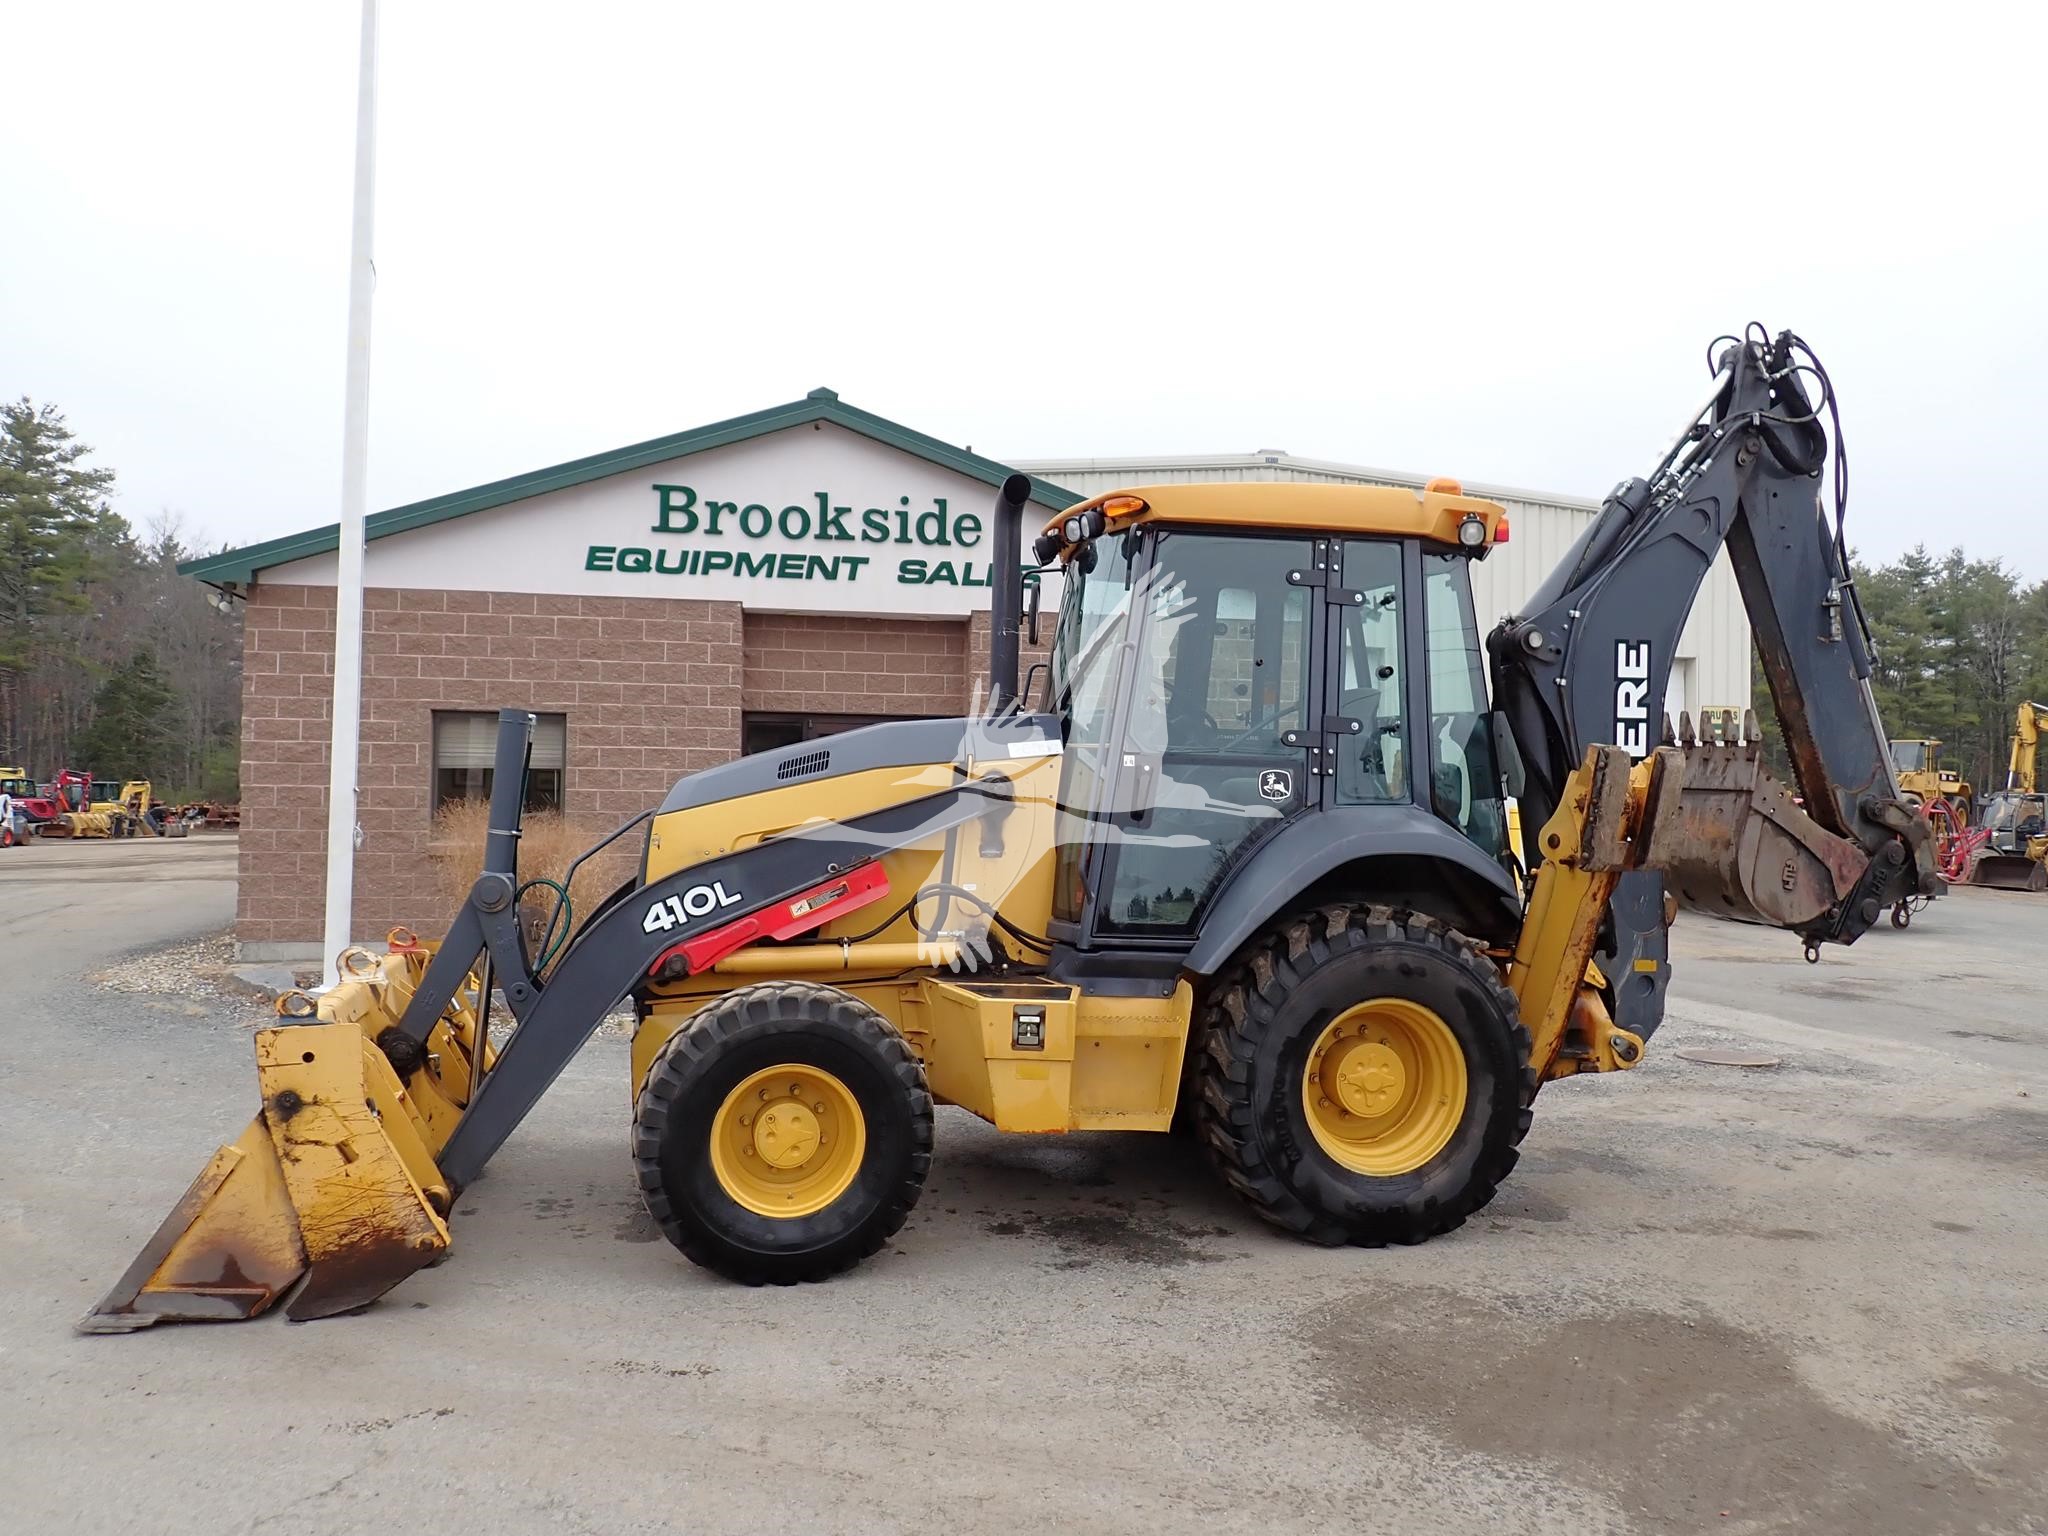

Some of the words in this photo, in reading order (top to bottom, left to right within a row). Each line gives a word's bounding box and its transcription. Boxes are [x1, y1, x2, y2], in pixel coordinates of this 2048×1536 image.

[651, 484, 982, 547] Brookside
[585, 546, 870, 581] EQUIPMENT
[897, 559, 1042, 589] SALS
[1616, 643, 1648, 757] ERE
[642, 881, 743, 933] 410L
